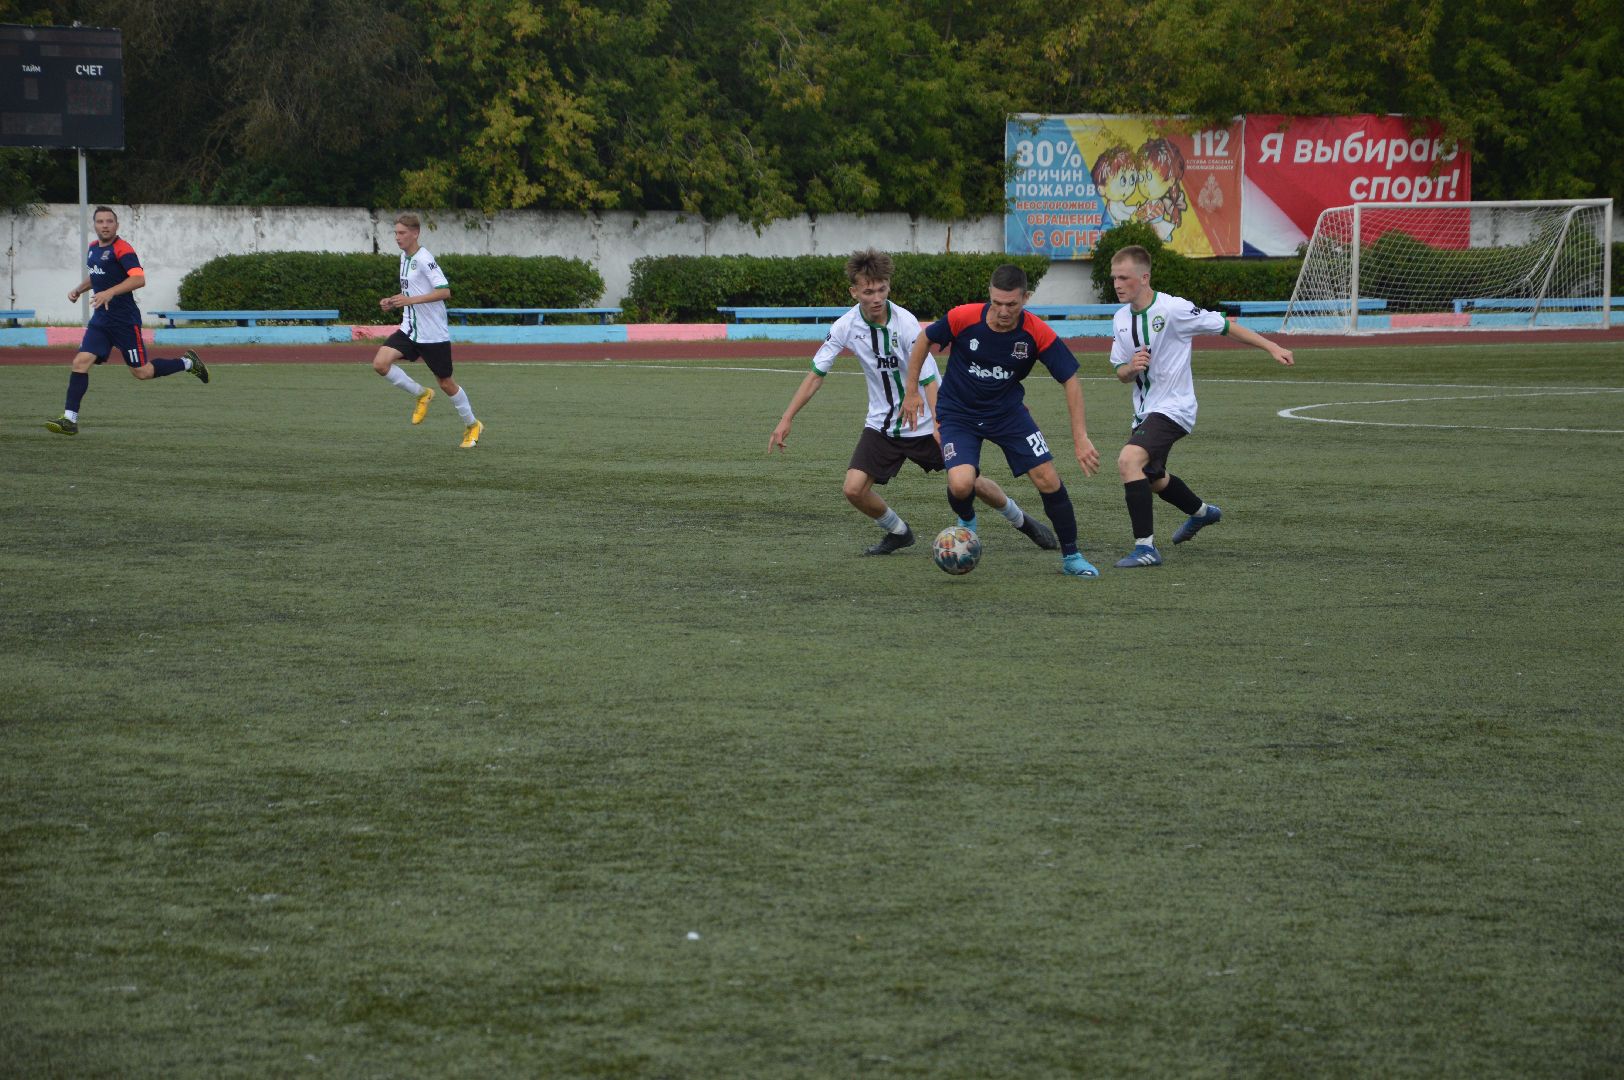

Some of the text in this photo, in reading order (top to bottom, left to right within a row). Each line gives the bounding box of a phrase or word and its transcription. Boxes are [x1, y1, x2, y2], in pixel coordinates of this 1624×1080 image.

[22, 64, 41, 73] ТАЙМ
[75, 64, 104, 76] СЧЕТ
[1192, 130, 1230, 156] 112
[1258, 132, 1285, 163] Я
[1016, 140, 1082, 168] 80%
[1015, 184, 1096, 197] ПОЖАРОВ
[1350, 169, 1460, 204] спорт!
[1016, 201, 1098, 210] НЕОСТОРОЖНОЕ
[1027, 214, 1102, 227] ОБРАЩЕНИЕ
[1032, 230, 1106, 248] С ОГНЕ
[128, 349, 139, 363] 11
